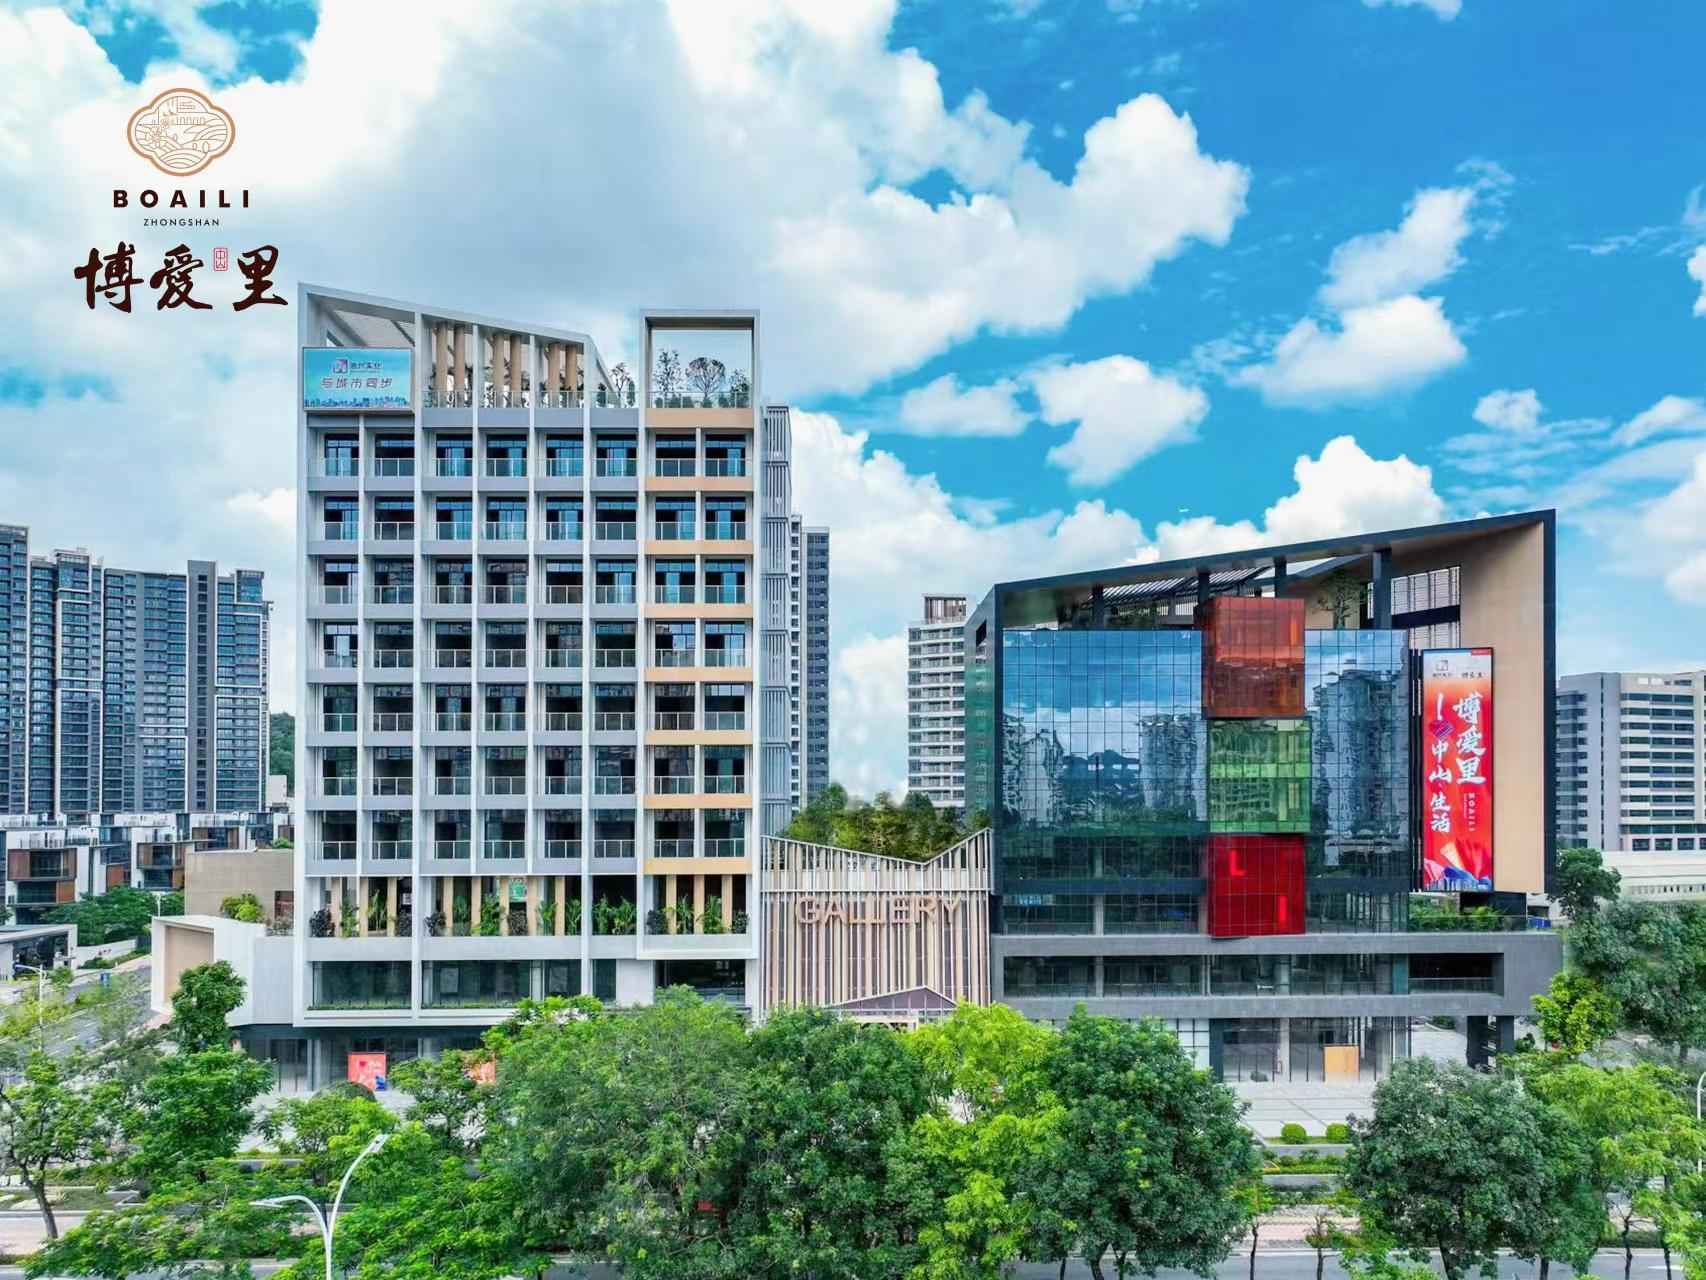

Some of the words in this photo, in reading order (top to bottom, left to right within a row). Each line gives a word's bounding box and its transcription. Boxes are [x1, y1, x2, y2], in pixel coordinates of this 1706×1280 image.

[321, 377, 393, 389] 与城市同步
[794, 893, 962, 925] GALLERY
